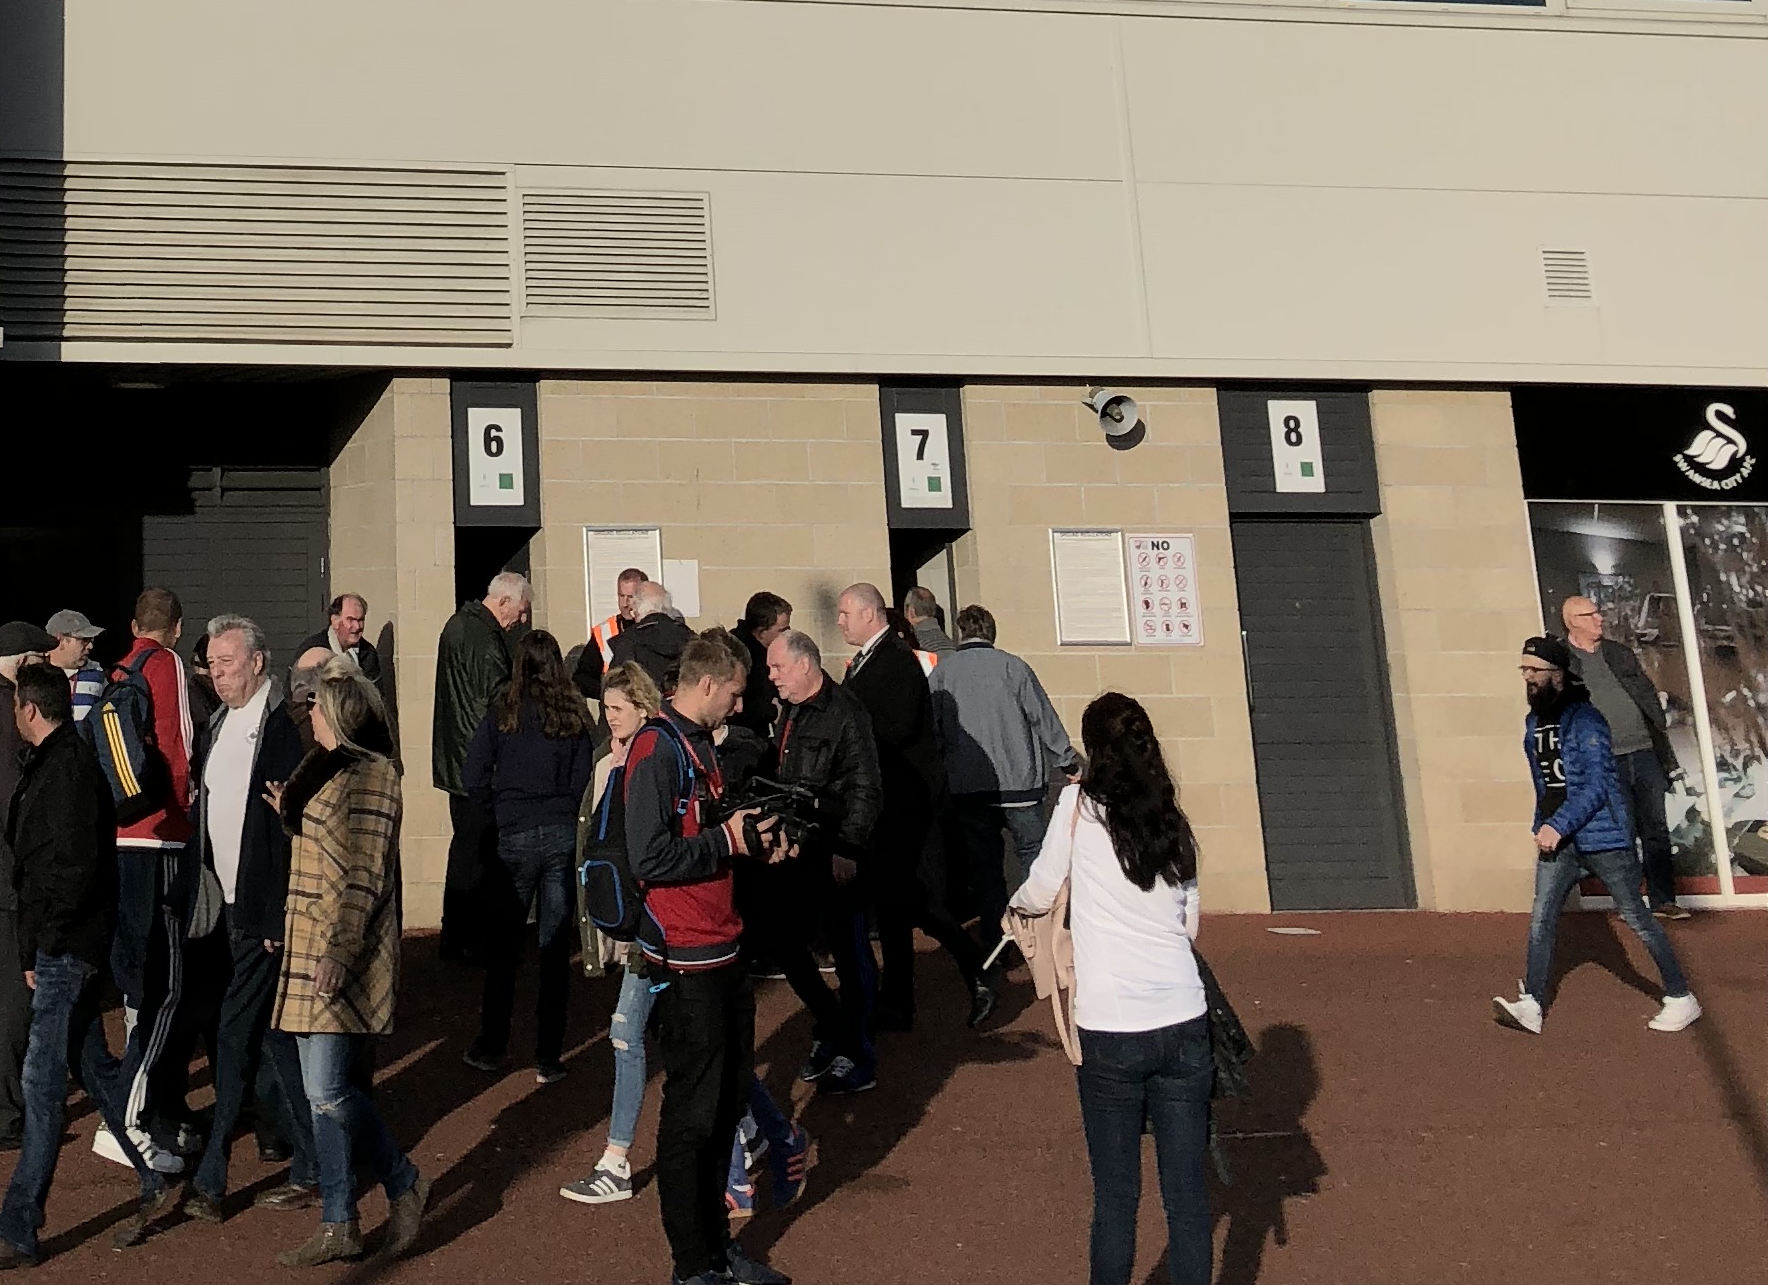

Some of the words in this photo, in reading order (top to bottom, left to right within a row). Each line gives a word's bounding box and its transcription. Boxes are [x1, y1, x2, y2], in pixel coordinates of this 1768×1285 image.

[484, 424, 504, 457] 6
[910, 429, 929, 461] 7
[1283, 415, 1303, 447] 8
[1672, 453, 1721, 490] SWANSEA
[1151, 540, 1171, 551] NO
